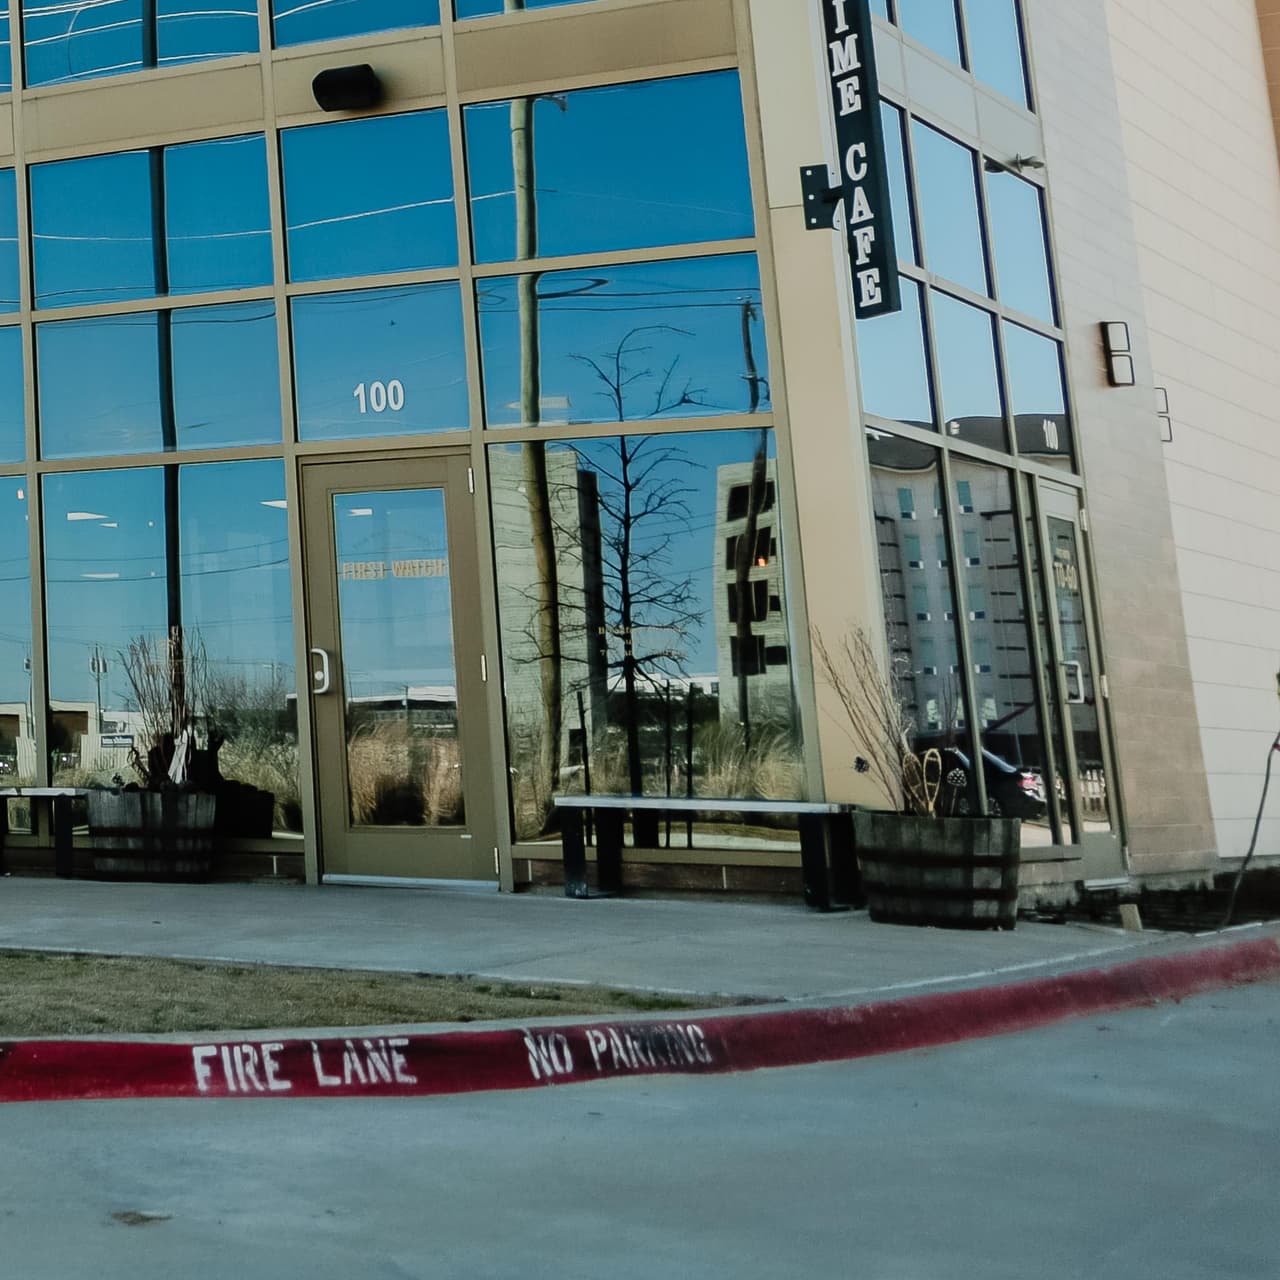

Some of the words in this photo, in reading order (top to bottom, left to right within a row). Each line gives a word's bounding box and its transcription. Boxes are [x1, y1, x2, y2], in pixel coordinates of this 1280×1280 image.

[845, 141, 882, 309] CAFE
[353, 379, 405, 414] 100
[342, 561, 387, 581] FIRST
[392, 558, 447, 578] WATCH
[192, 1041, 293, 1093] FIRE
[312, 1037, 418, 1087] LANE
[522, 1027, 574, 1080] NO
